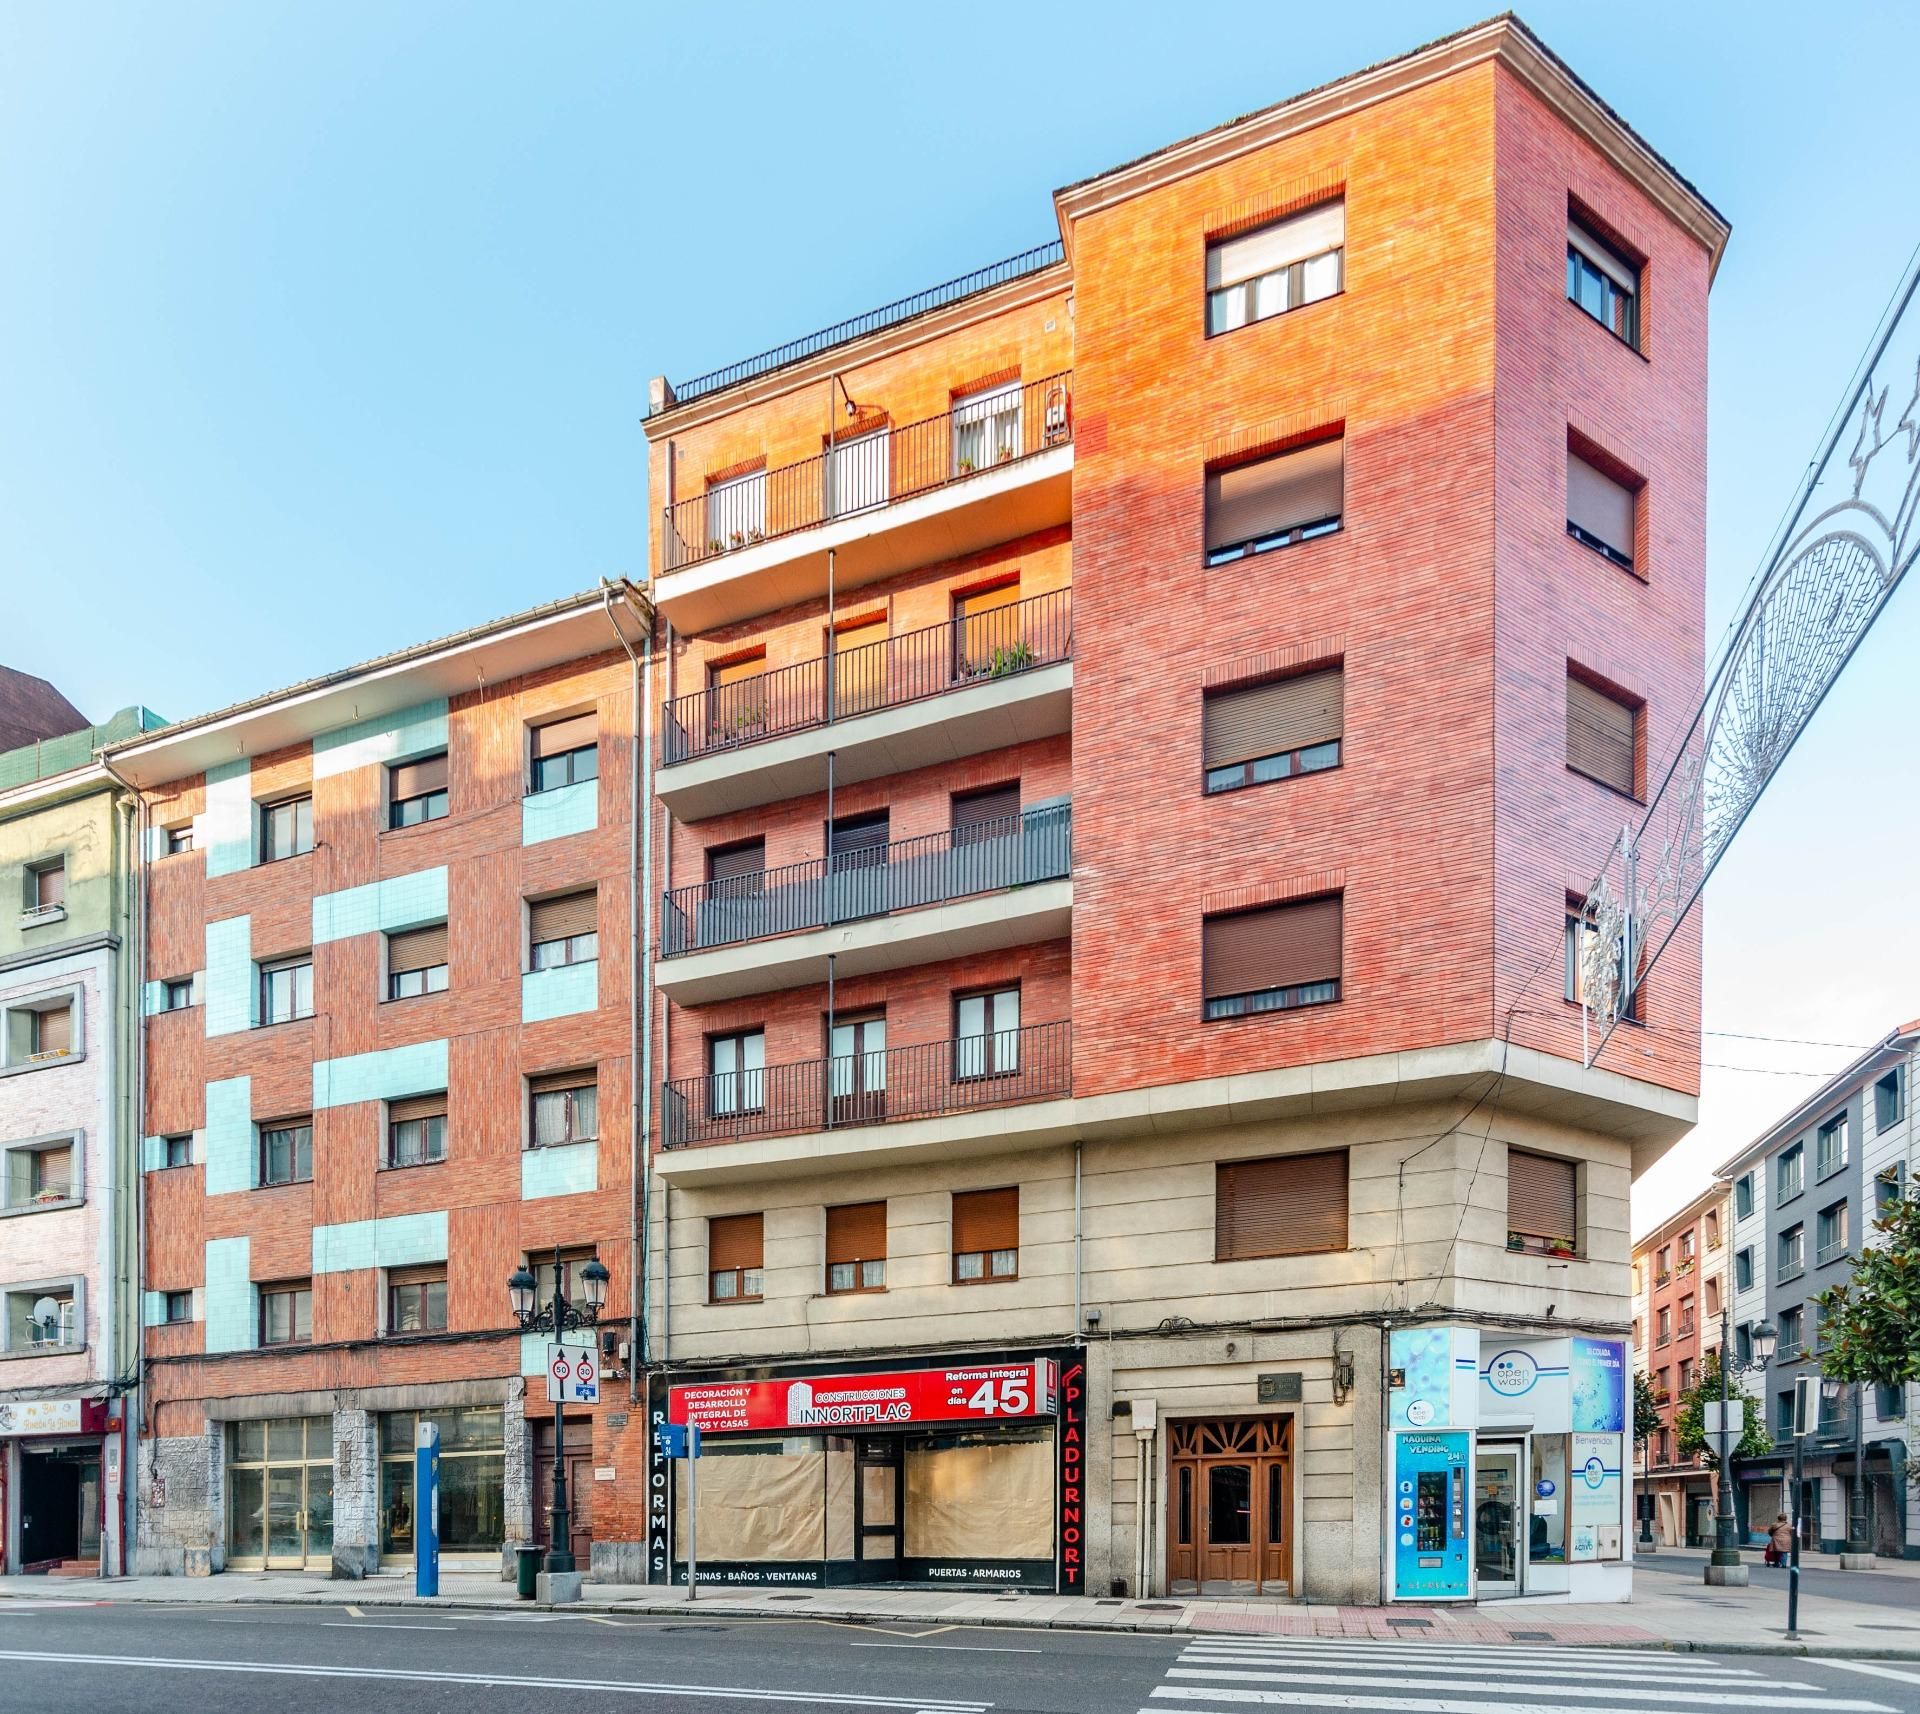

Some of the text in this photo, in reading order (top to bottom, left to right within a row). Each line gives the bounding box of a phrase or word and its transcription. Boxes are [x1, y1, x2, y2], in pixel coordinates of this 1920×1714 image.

[1226, 1343, 1236, 1358] 9
[556, 1366, 567, 1374] 50
[580, 1368, 590, 1376] 30
[1497, 1369, 1529, 1379] open
[945, 1371, 988, 1381] Reforma
[1498, 1376, 1529, 1386] wash
[684, 1388, 751, 1400] DECORACIÓN Y
[815, 1388, 906, 1403] CONSTRUCCIONES
[968, 1379, 1029, 1415] 45
[688, 1399, 747, 1409] DESARROLLO
[947, 1396, 967, 1405] días
[688, 1409, 746, 1420] INTEGRAL DE
[800, 1403, 911, 1423] INNORTPLAC
[713, 1420, 719, 1429] Y
[720, 1420, 749, 1429] CASAS
[1409, 1445, 1449, 1454] VENDING
[1064, 1387, 1081, 1583] PLADURNORT
[651, 1411, 667, 1571] REFORMAS
[728, 1570, 760, 1581] BAÑOS
[766, 1572, 817, 1581] VENTANAS
[929, 1568, 1022, 1578] PUERTAS ARMARIOS
